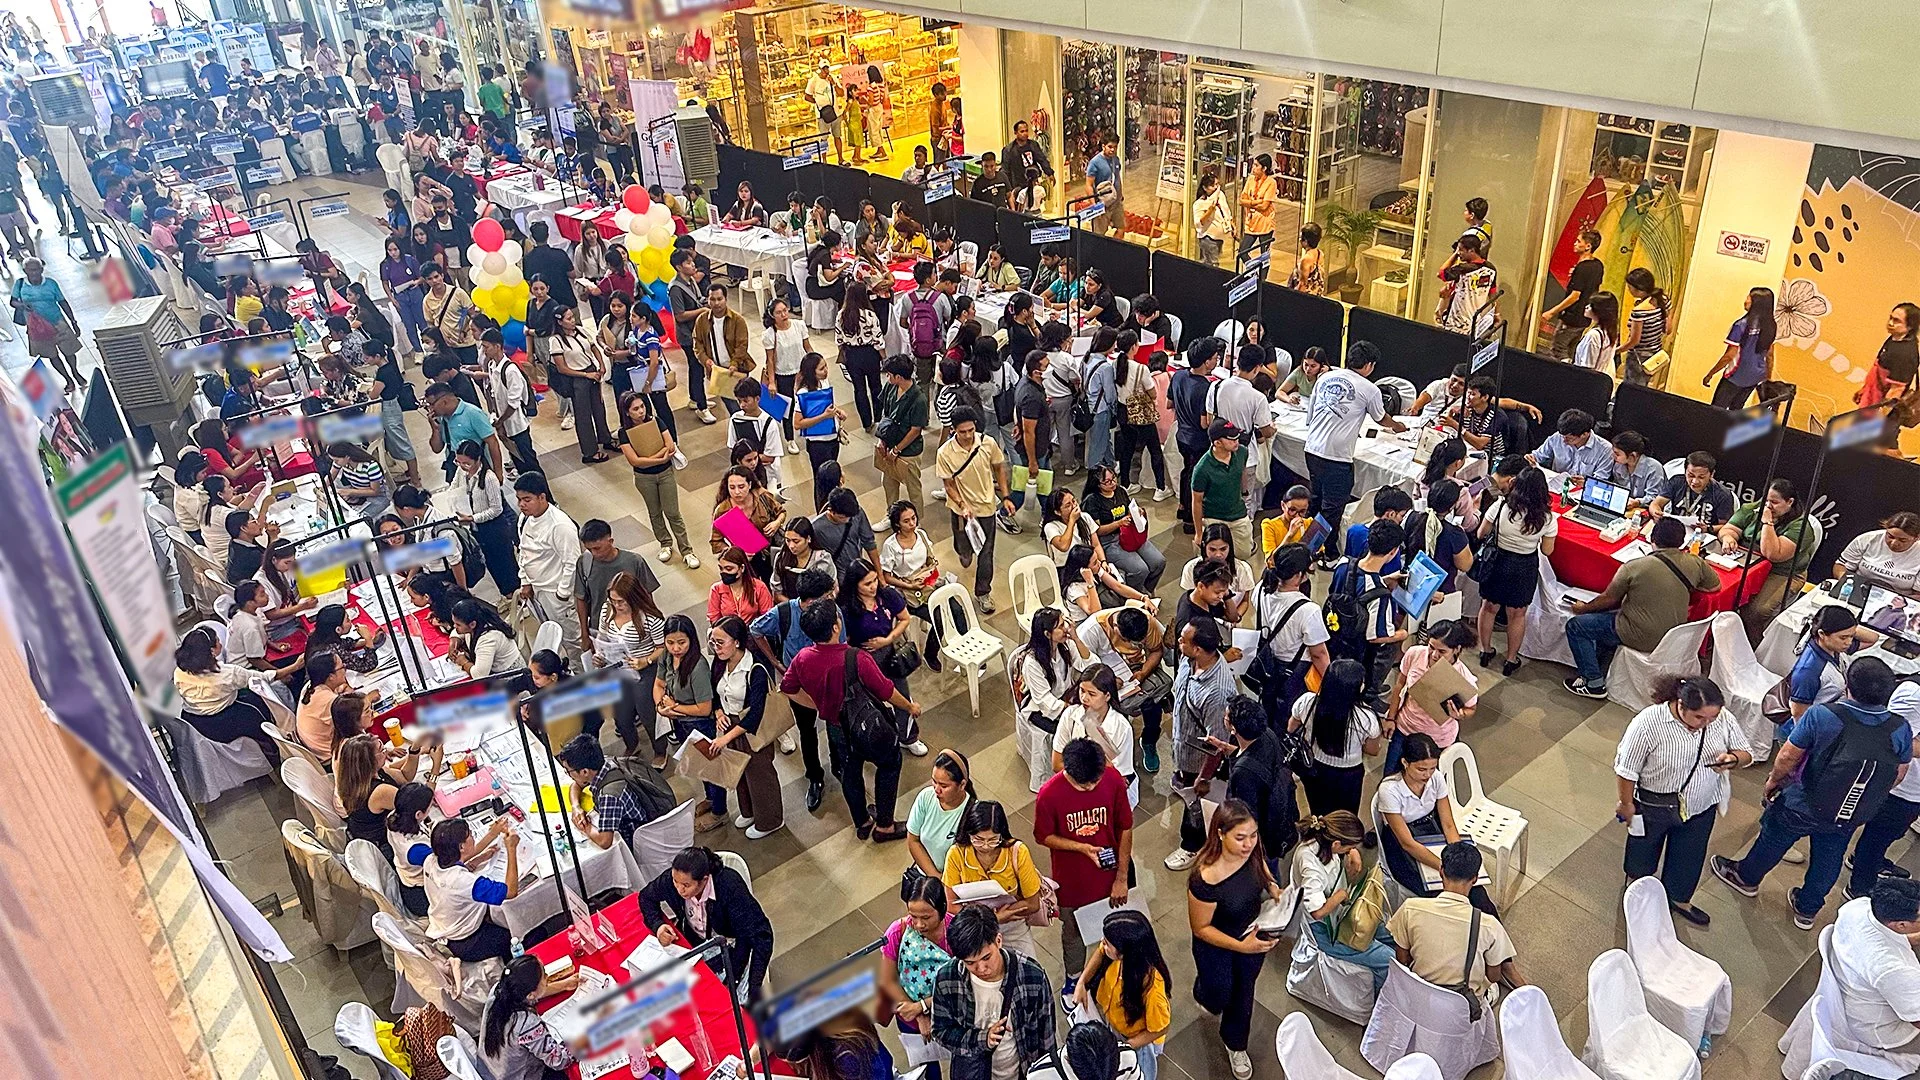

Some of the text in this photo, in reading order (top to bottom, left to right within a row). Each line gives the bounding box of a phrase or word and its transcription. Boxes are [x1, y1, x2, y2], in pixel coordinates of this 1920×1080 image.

[1748, 240, 1766, 251] SMOKING
[1861, 561, 1913, 581] SUTHERLAND
[1839, 786, 1865, 817] PUMA
[1066, 806, 1107, 832] SULLEN
